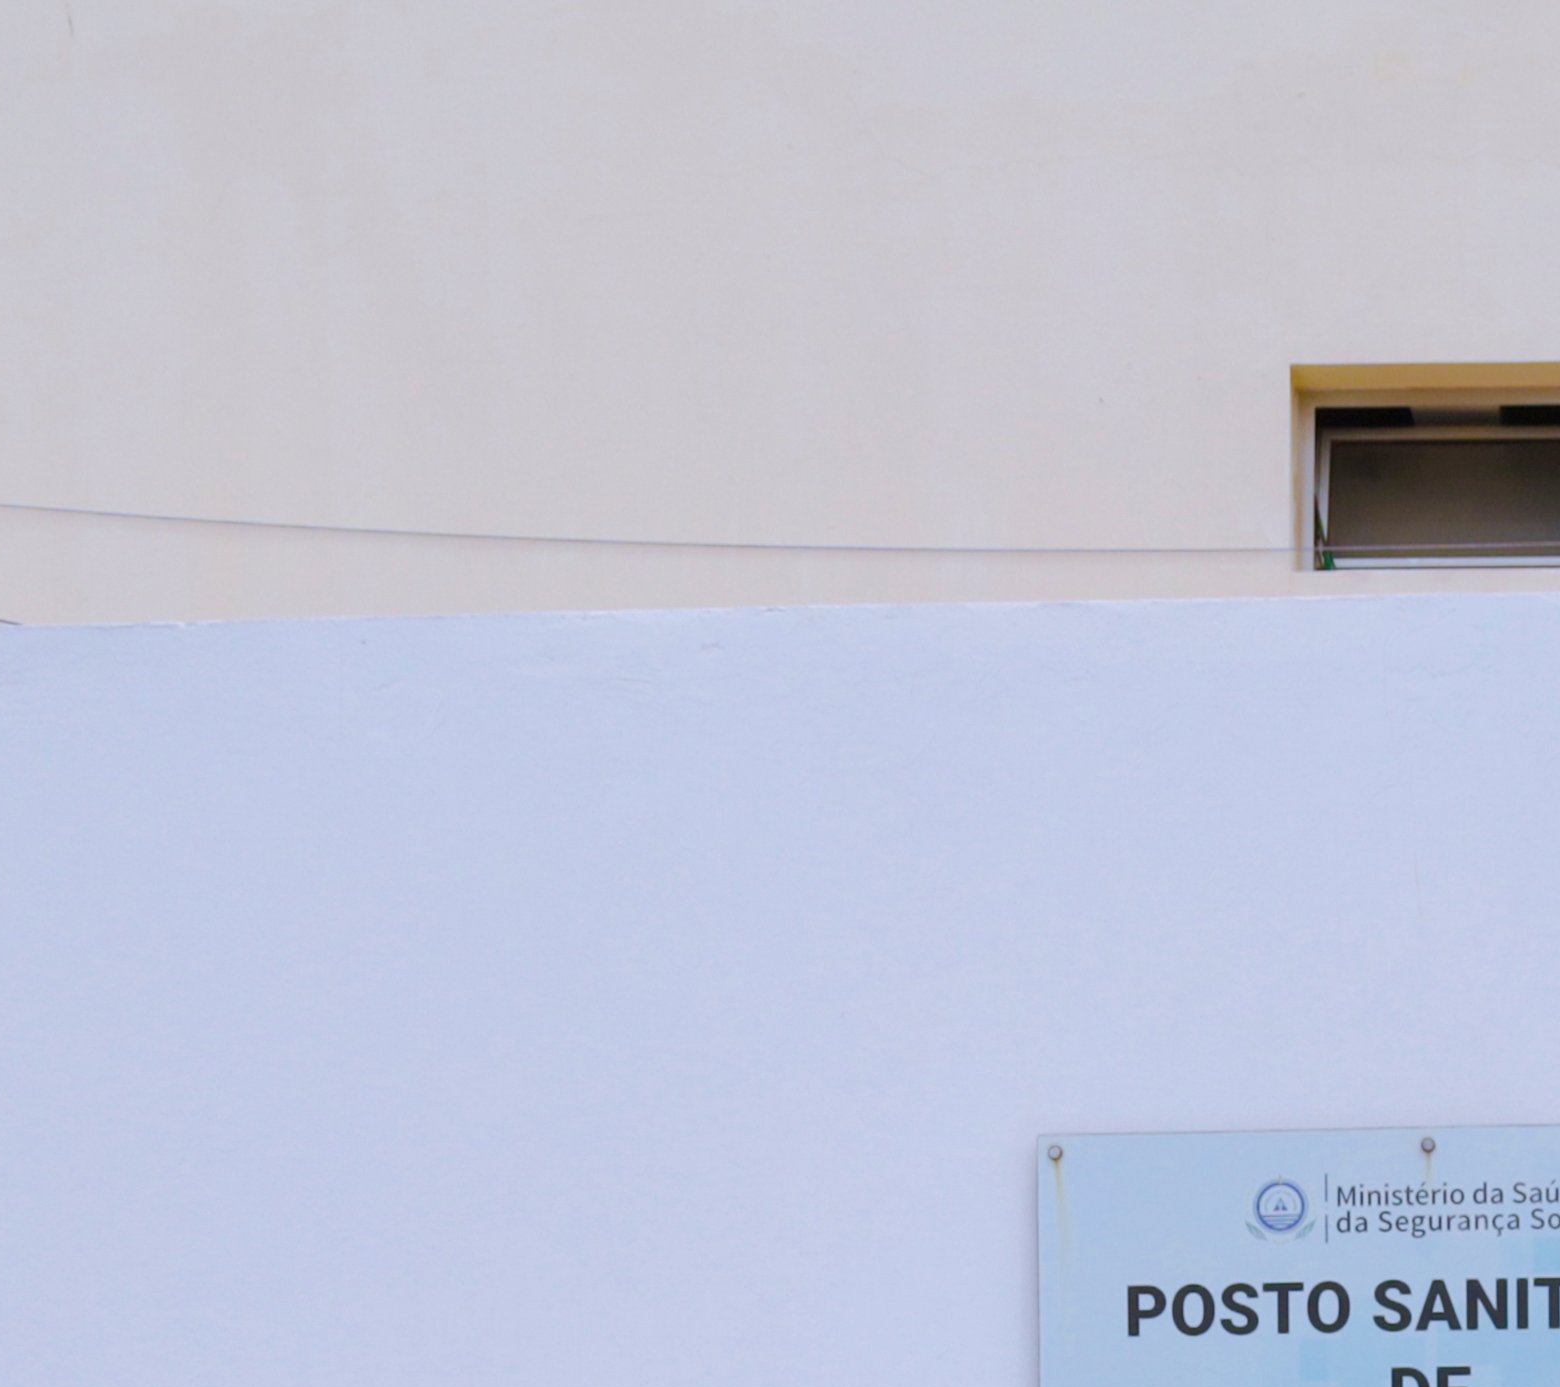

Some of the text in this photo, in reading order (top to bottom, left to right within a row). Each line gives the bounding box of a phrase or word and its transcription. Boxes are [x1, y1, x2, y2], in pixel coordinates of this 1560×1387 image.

[1336, 1182, 1465, 1207] Ministério
[1473, 1182, 1504, 1205] da
[1336, 1211, 1368, 1233] da
[1378, 1211, 1520, 1238] Segurança
[1127, 1281, 1351, 1337] POSTO
